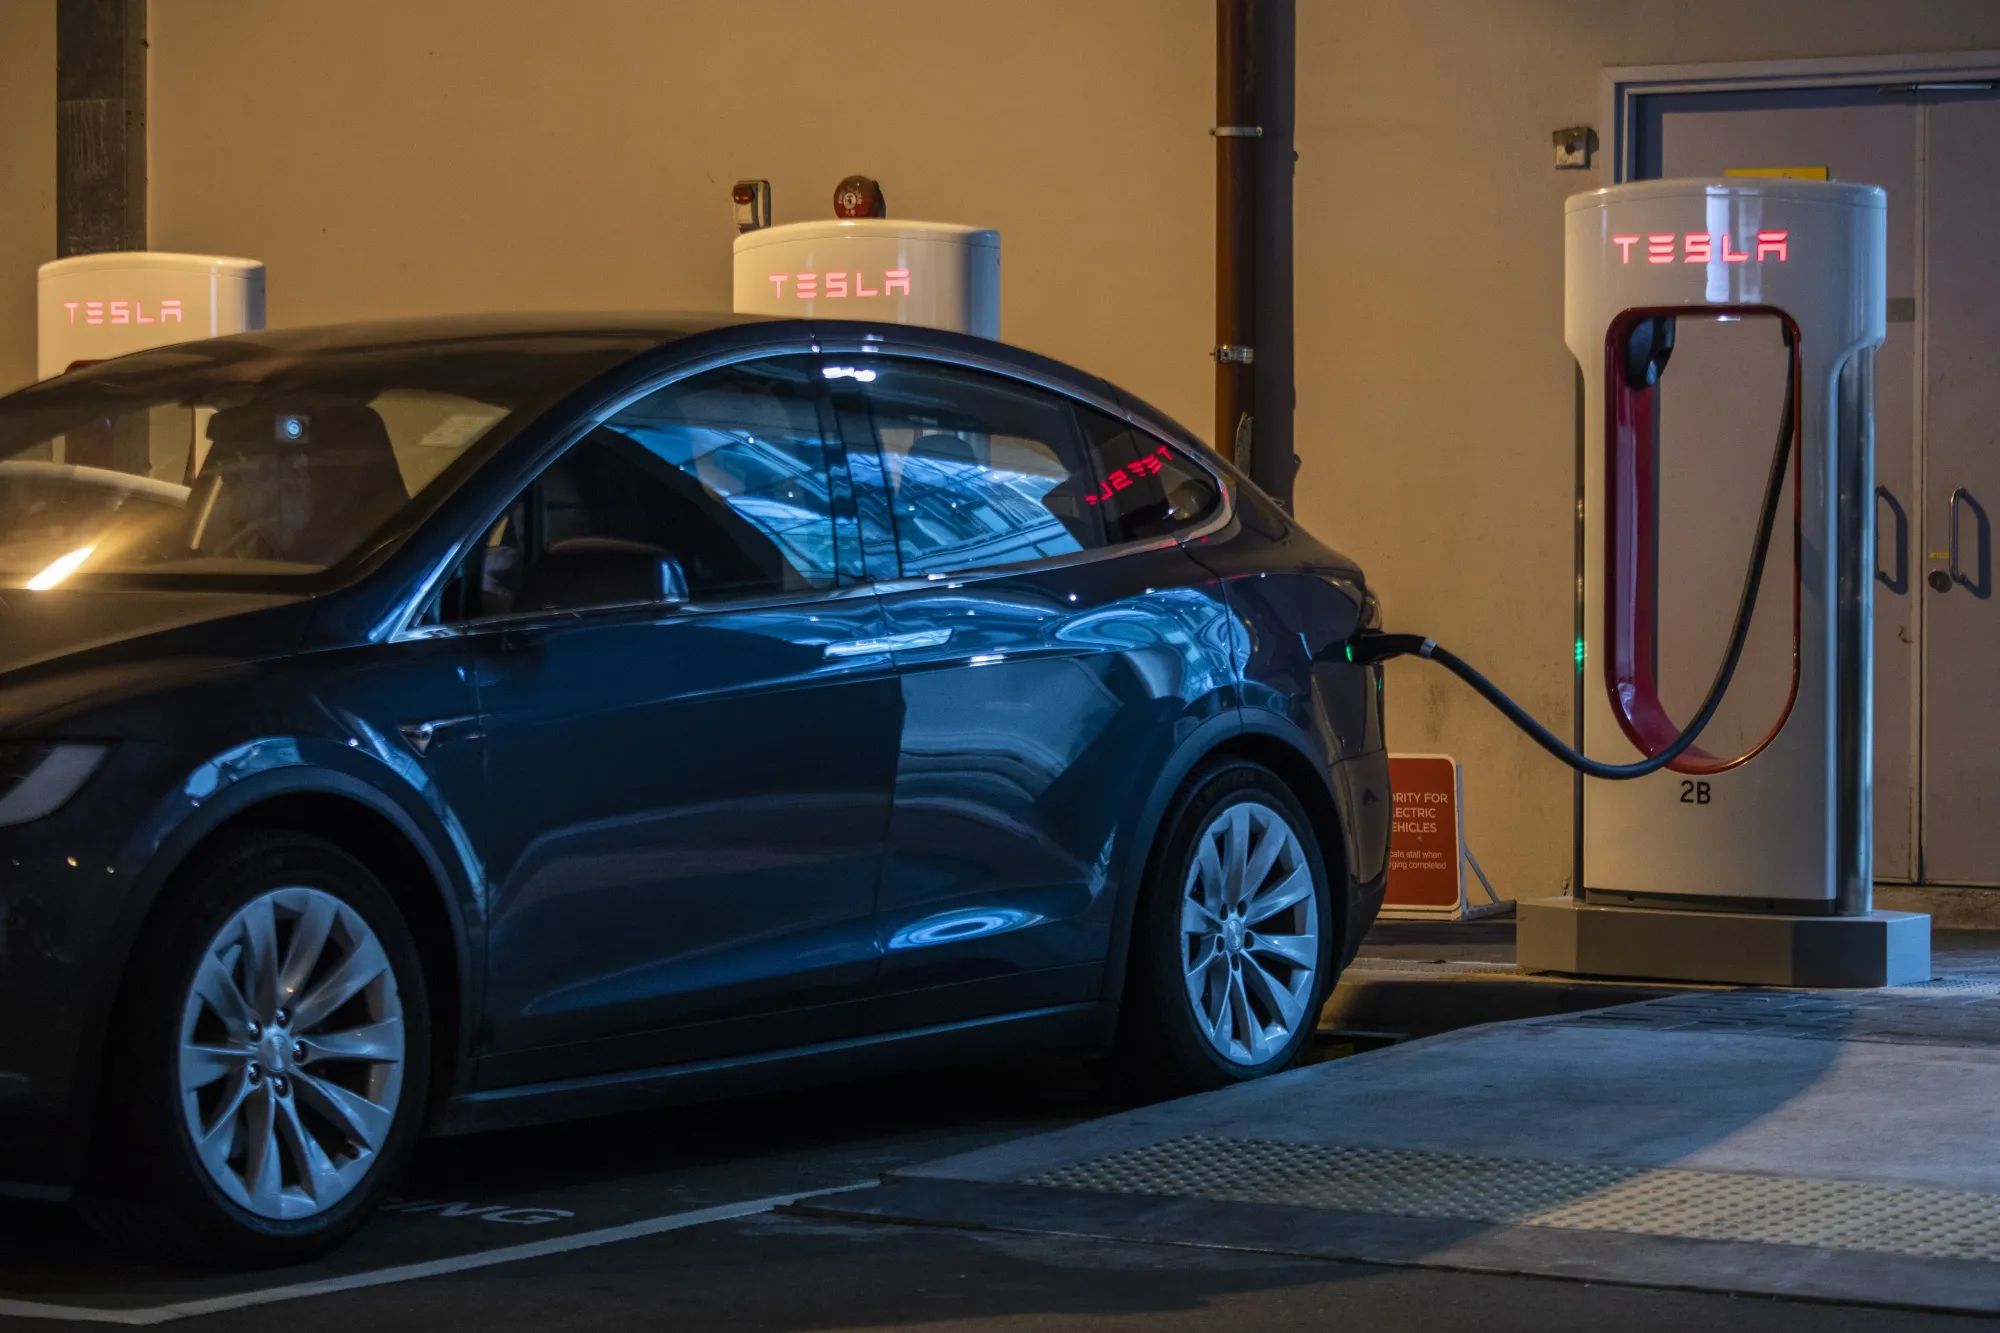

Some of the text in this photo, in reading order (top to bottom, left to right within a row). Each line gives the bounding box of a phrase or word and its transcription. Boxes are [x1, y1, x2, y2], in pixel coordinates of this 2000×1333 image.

[1612, 231, 1788, 264] TESLA
[769, 270, 911, 299] TESLA
[63, 300, 183, 325] TESLA
[1393, 792, 1448, 804] RITY FOR
[1680, 780, 1711, 804] 2B
[1392, 807, 1437, 818] ECTRIC
[1392, 822, 1437, 833] EHICLES
[1390, 850, 1405, 858] cate
[1422, 850, 1442, 858] when
[1389, 861, 1447, 870] rging completed
